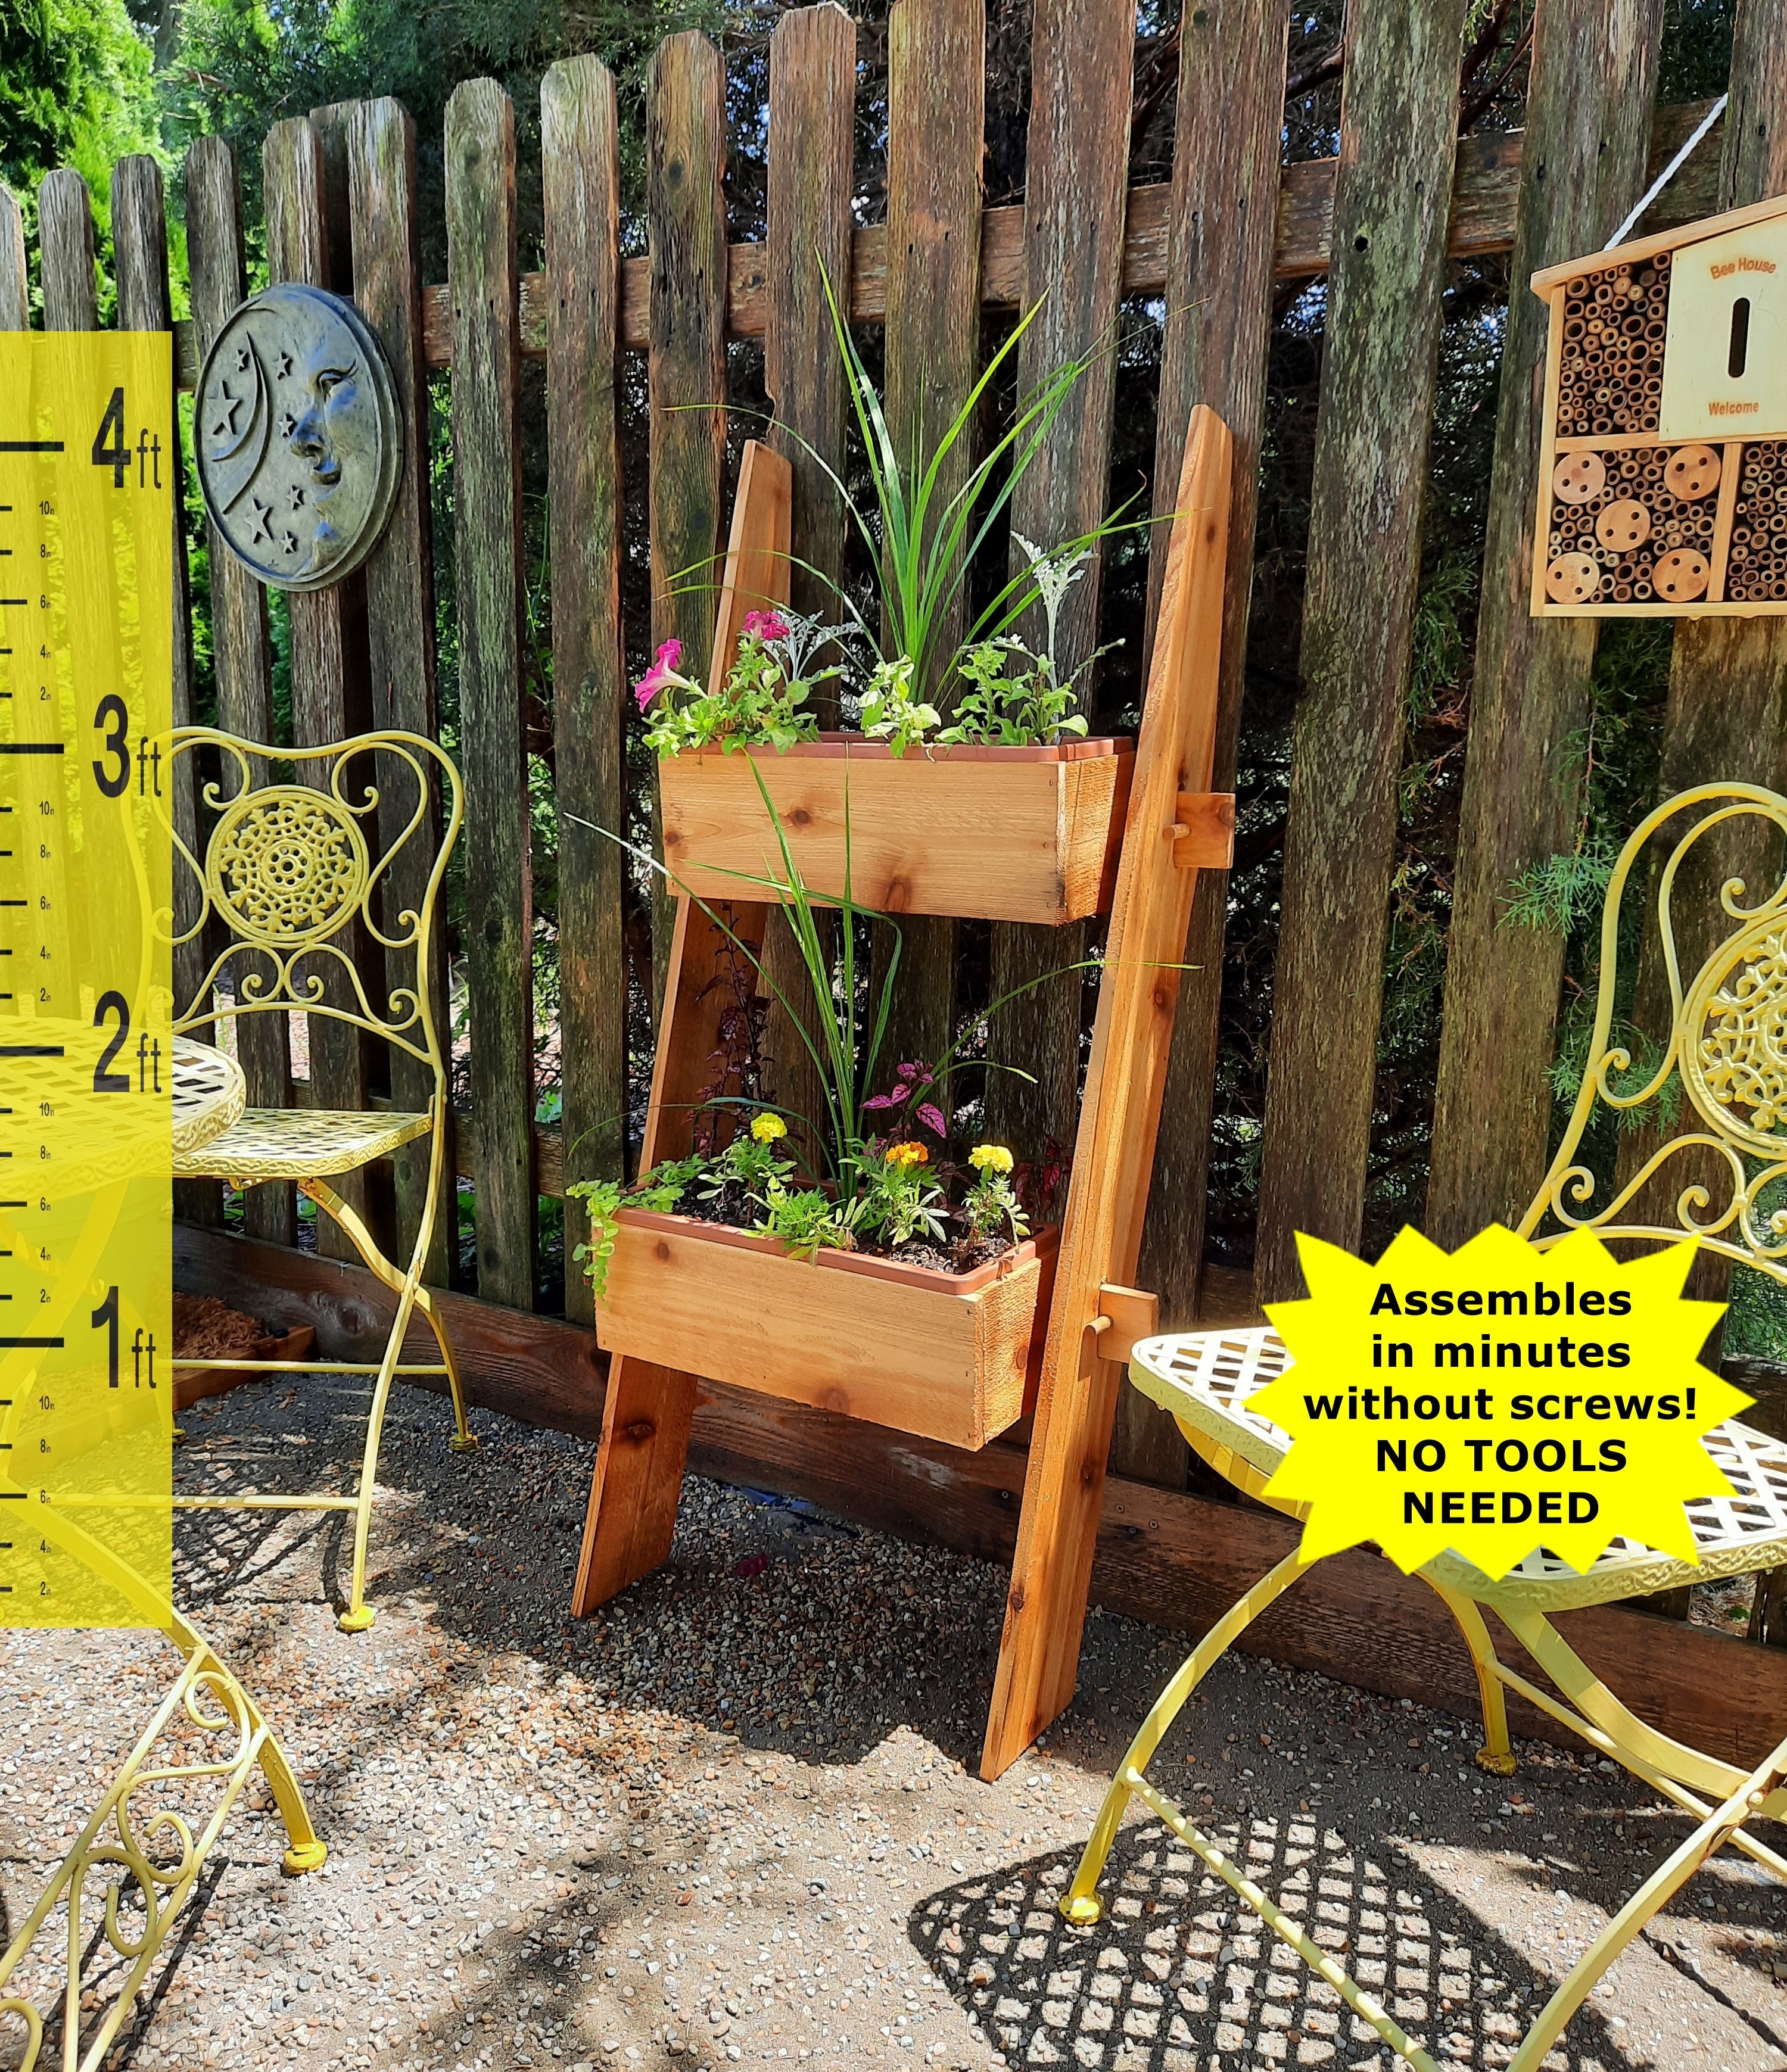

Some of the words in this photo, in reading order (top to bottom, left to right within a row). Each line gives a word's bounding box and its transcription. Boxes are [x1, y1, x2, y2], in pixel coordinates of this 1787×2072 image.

[1710, 263, 1736, 279] Bee
[1738, 257, 1776, 274] House
[1708, 401, 1759, 416] Welcome
